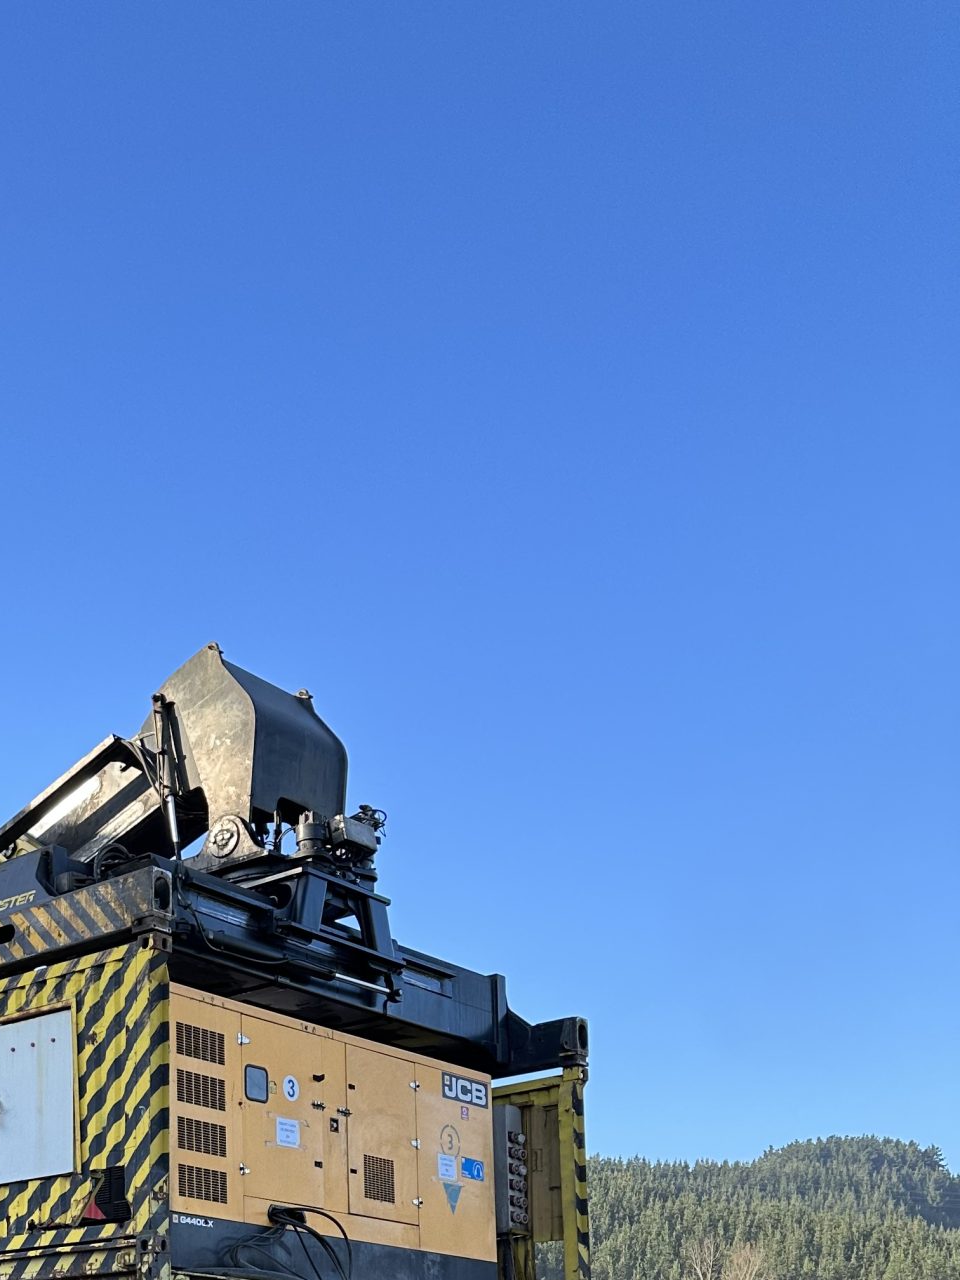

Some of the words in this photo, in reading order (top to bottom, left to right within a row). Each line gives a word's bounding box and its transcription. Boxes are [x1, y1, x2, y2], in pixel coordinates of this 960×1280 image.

[286, 1079, 296, 1098] 3
[444, 1076, 487, 1106] JCB
[447, 1133, 454, 1151] 3
